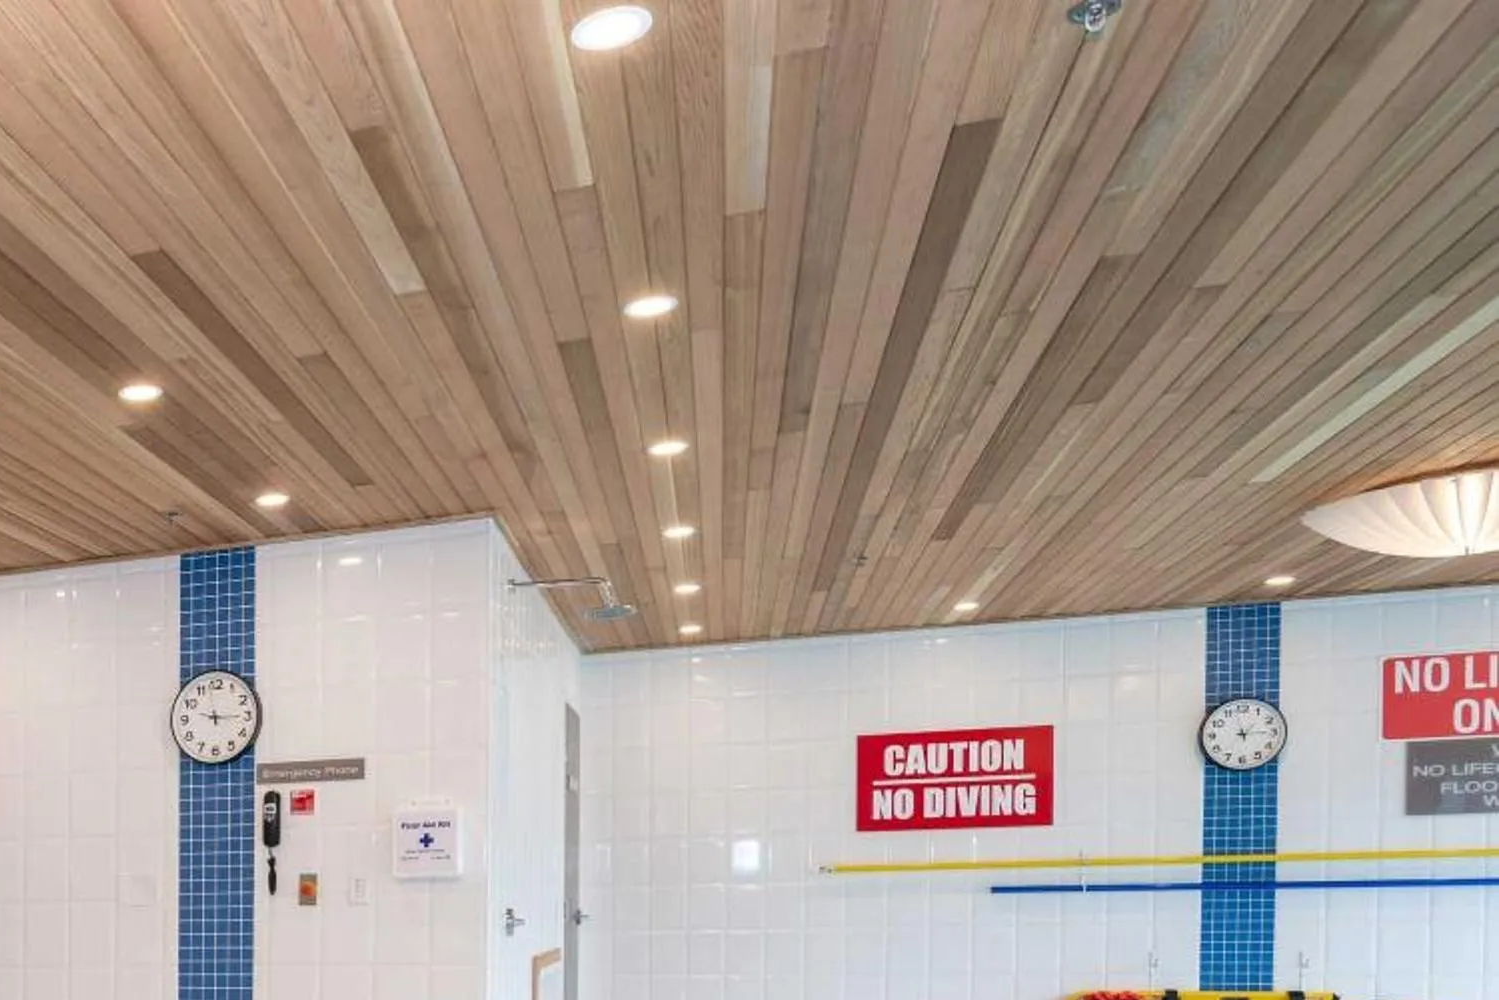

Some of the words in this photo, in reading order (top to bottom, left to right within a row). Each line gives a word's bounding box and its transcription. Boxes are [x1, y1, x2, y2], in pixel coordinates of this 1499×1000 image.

[1393, 656, 1450, 695] NO
[883, 738, 1025, 777] CAUTION
[1413, 764, 1445, 777] NO
[1452, 762, 1499, 777] LIFE
[872, 787, 915, 821] NO
[922, 782, 1037, 819] DIVING
